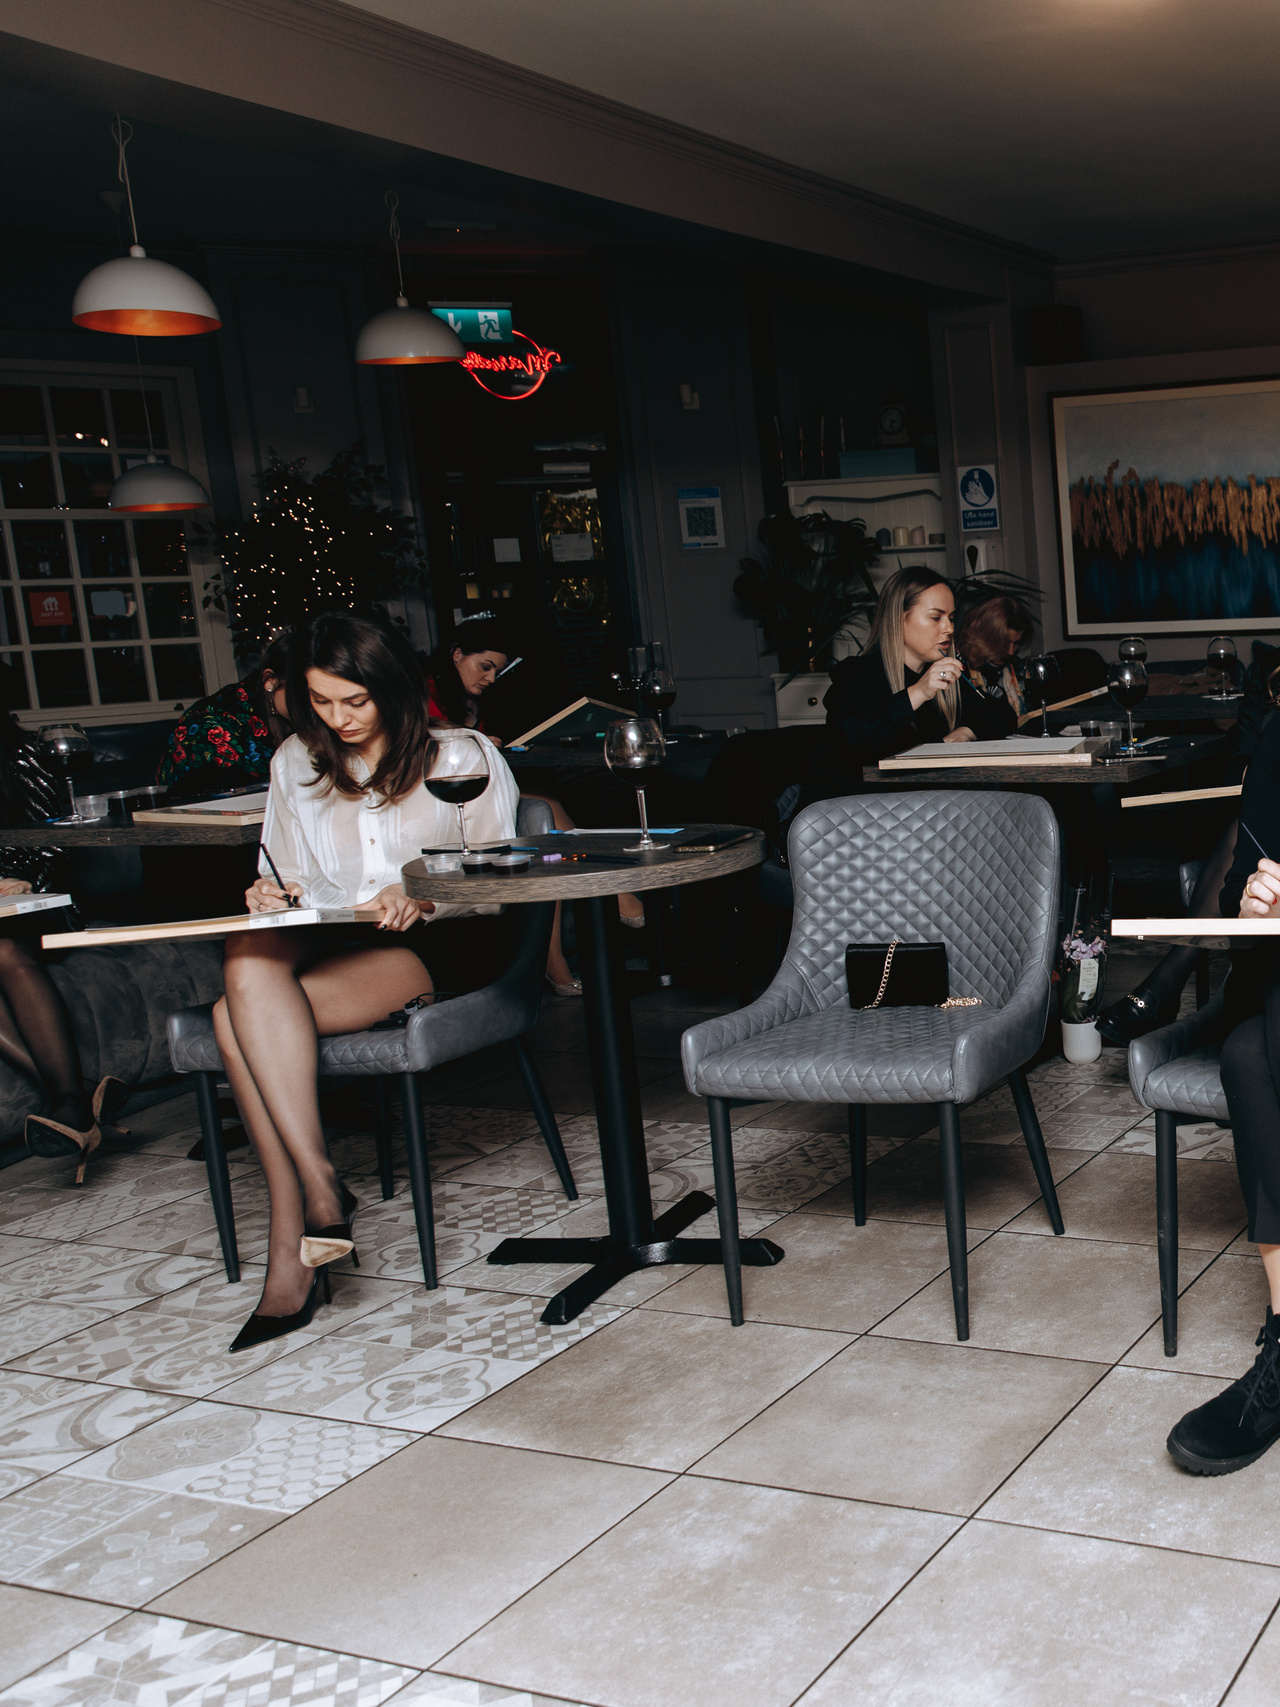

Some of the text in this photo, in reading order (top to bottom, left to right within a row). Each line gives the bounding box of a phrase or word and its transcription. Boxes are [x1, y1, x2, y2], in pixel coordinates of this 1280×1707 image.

[964, 510, 995, 519] Use hand
[966, 519, 994, 527] sanitiser
